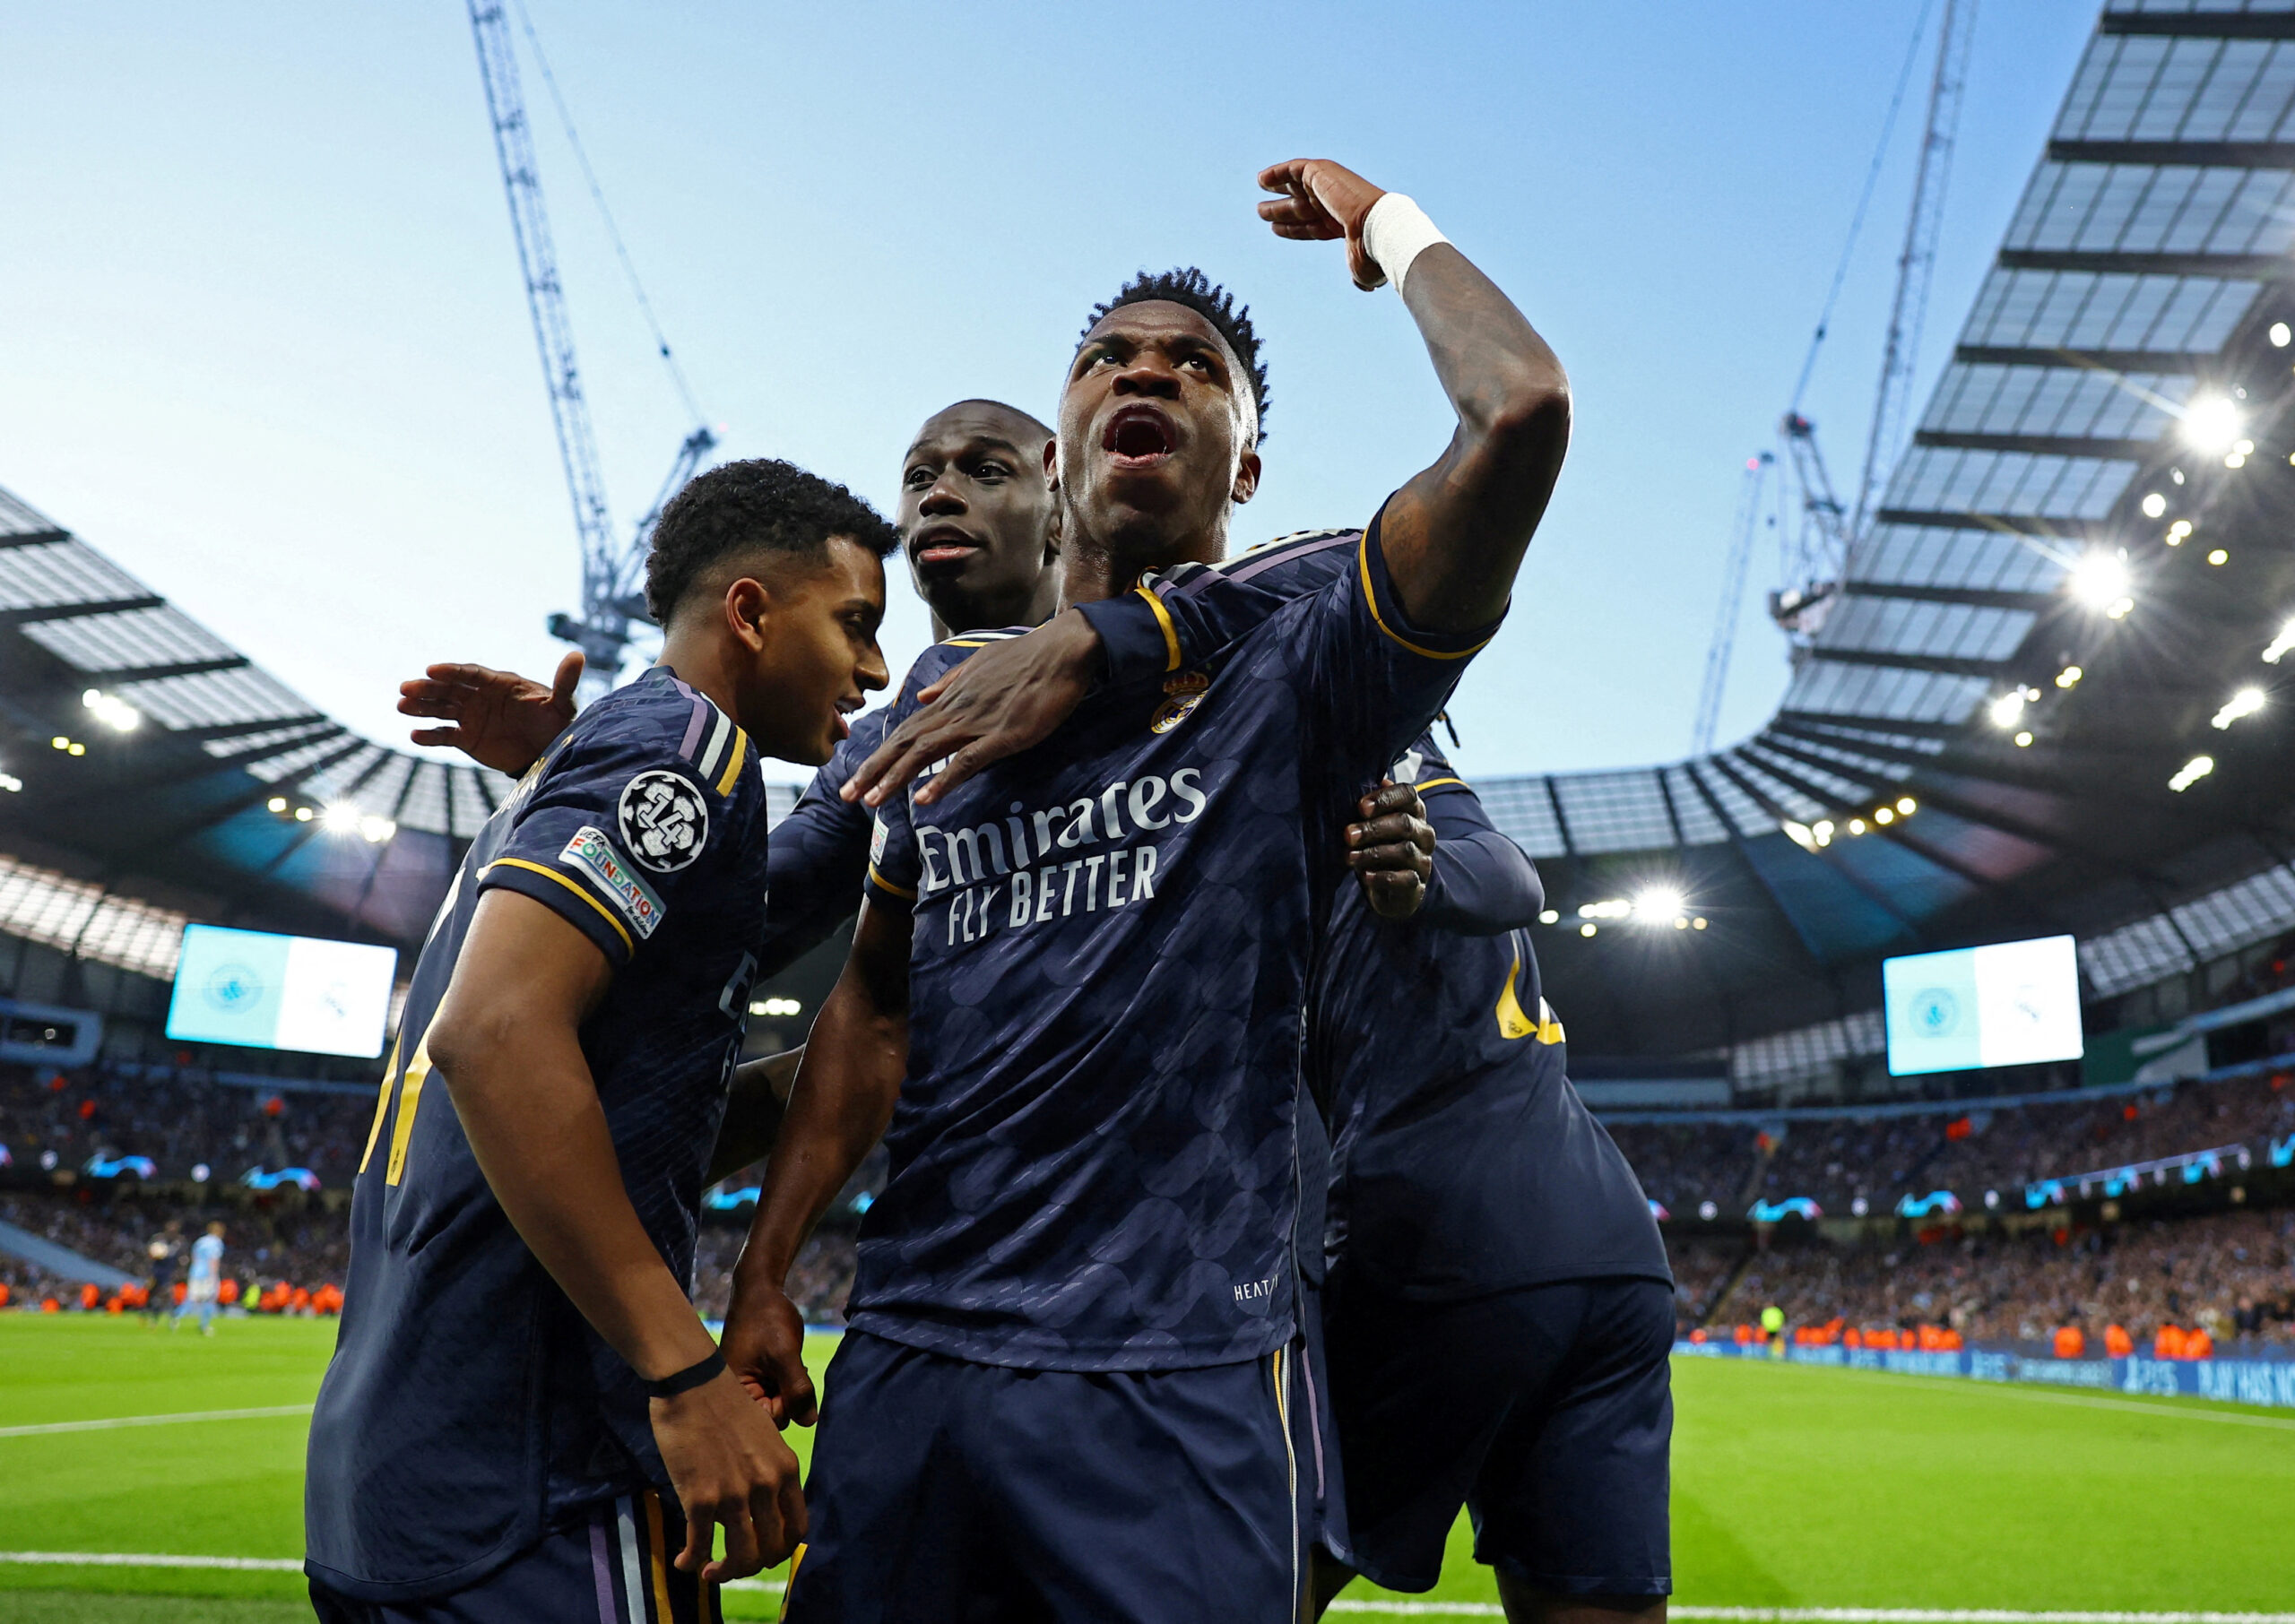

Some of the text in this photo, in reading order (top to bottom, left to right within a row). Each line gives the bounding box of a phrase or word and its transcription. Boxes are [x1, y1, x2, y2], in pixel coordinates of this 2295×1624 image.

[579, 830, 606, 848] UEFA
[639, 792, 684, 847] 14
[915, 767, 1207, 892] Emirates
[948, 845, 1158, 946] FLY BETTER
